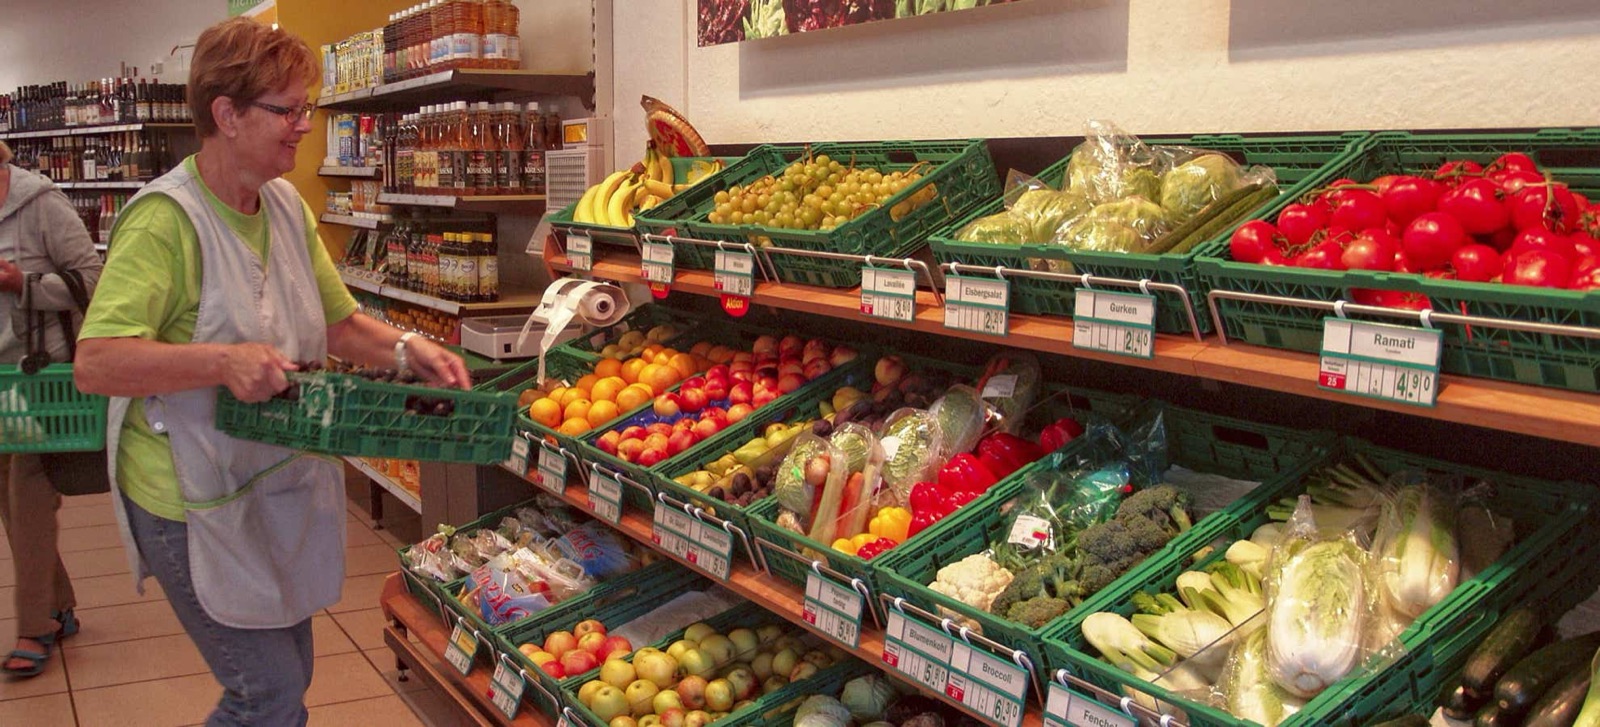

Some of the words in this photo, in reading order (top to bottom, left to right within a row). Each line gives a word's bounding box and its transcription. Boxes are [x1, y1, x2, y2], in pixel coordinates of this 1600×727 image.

[725, 297, 744, 309] Aktion
[965, 286, 1003, 300] Eisbergsalat
[1109, 302, 1137, 315] Gurken
[1125, 330, 1148, 353] 2.40
[1373, 333, 1415, 349] Ramati
[1396, 372, 1431, 399] 4.90
[909, 628, 947, 653] Blumenkohl
[982, 662, 1013, 684] Broccoli
[994, 699, 1018, 721] 6.30
